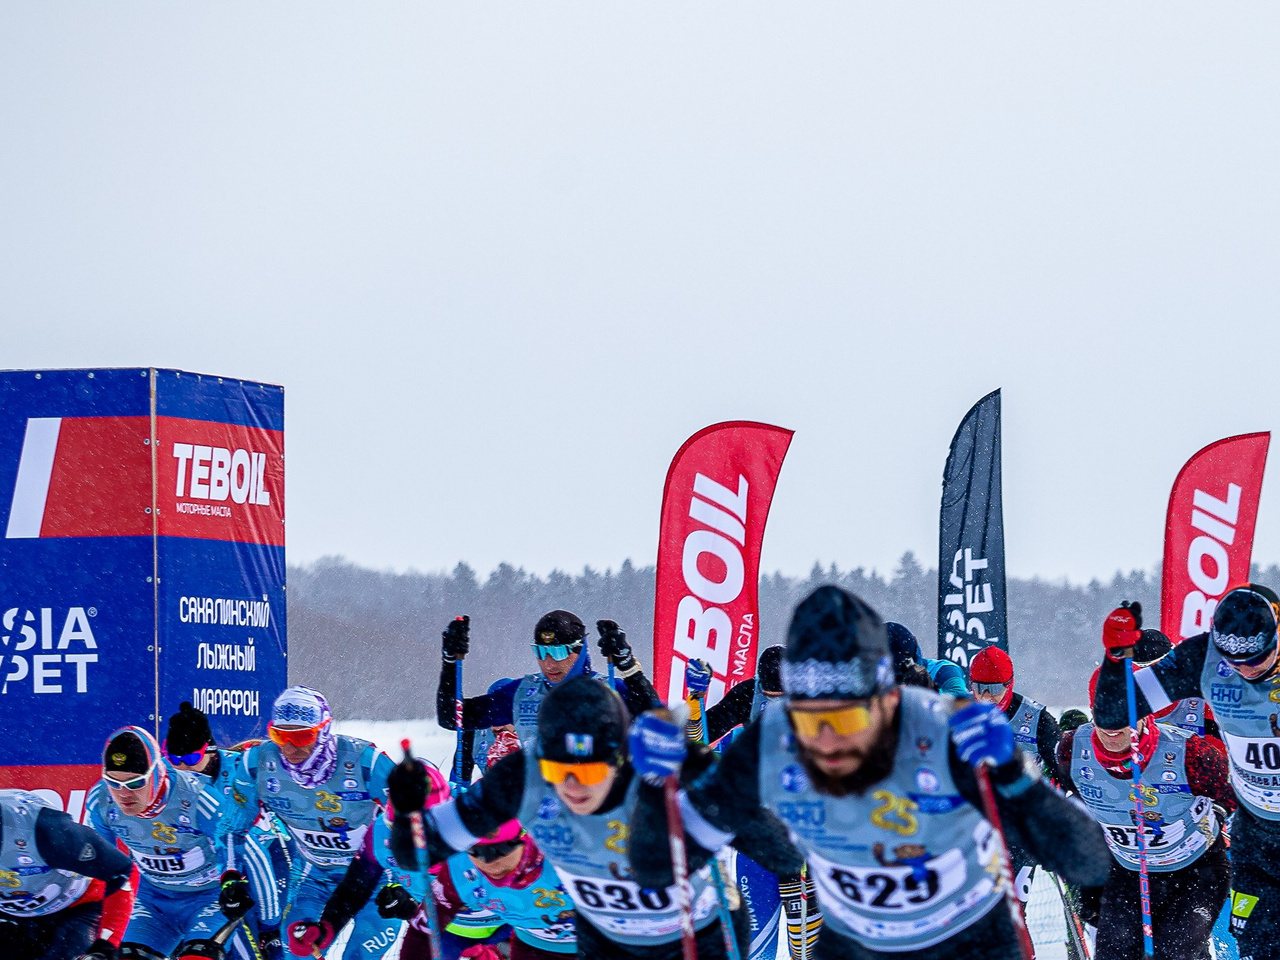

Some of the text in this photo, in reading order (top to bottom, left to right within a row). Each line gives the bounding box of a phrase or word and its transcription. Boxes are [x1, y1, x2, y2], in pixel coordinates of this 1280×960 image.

[173, 443, 270, 506] TEBOIL
[180, 594, 270, 628] САХАЛИНСКИЙ
[197, 637, 256, 671] ЛЫЖНЫЙ
[0, 653, 98, 694] PET
[193, 688, 259, 716] МАРАФОН
[315, 791, 343, 814] 25
[871, 790, 919, 837] 25
[152, 821, 178, 844] 25
[532, 888, 566, 908] 25
[573, 879, 672, 911] 630
[740, 875, 760, 931] САХАЛИН
[831, 868, 940, 908] 629
[362, 927, 397, 954] RUS
